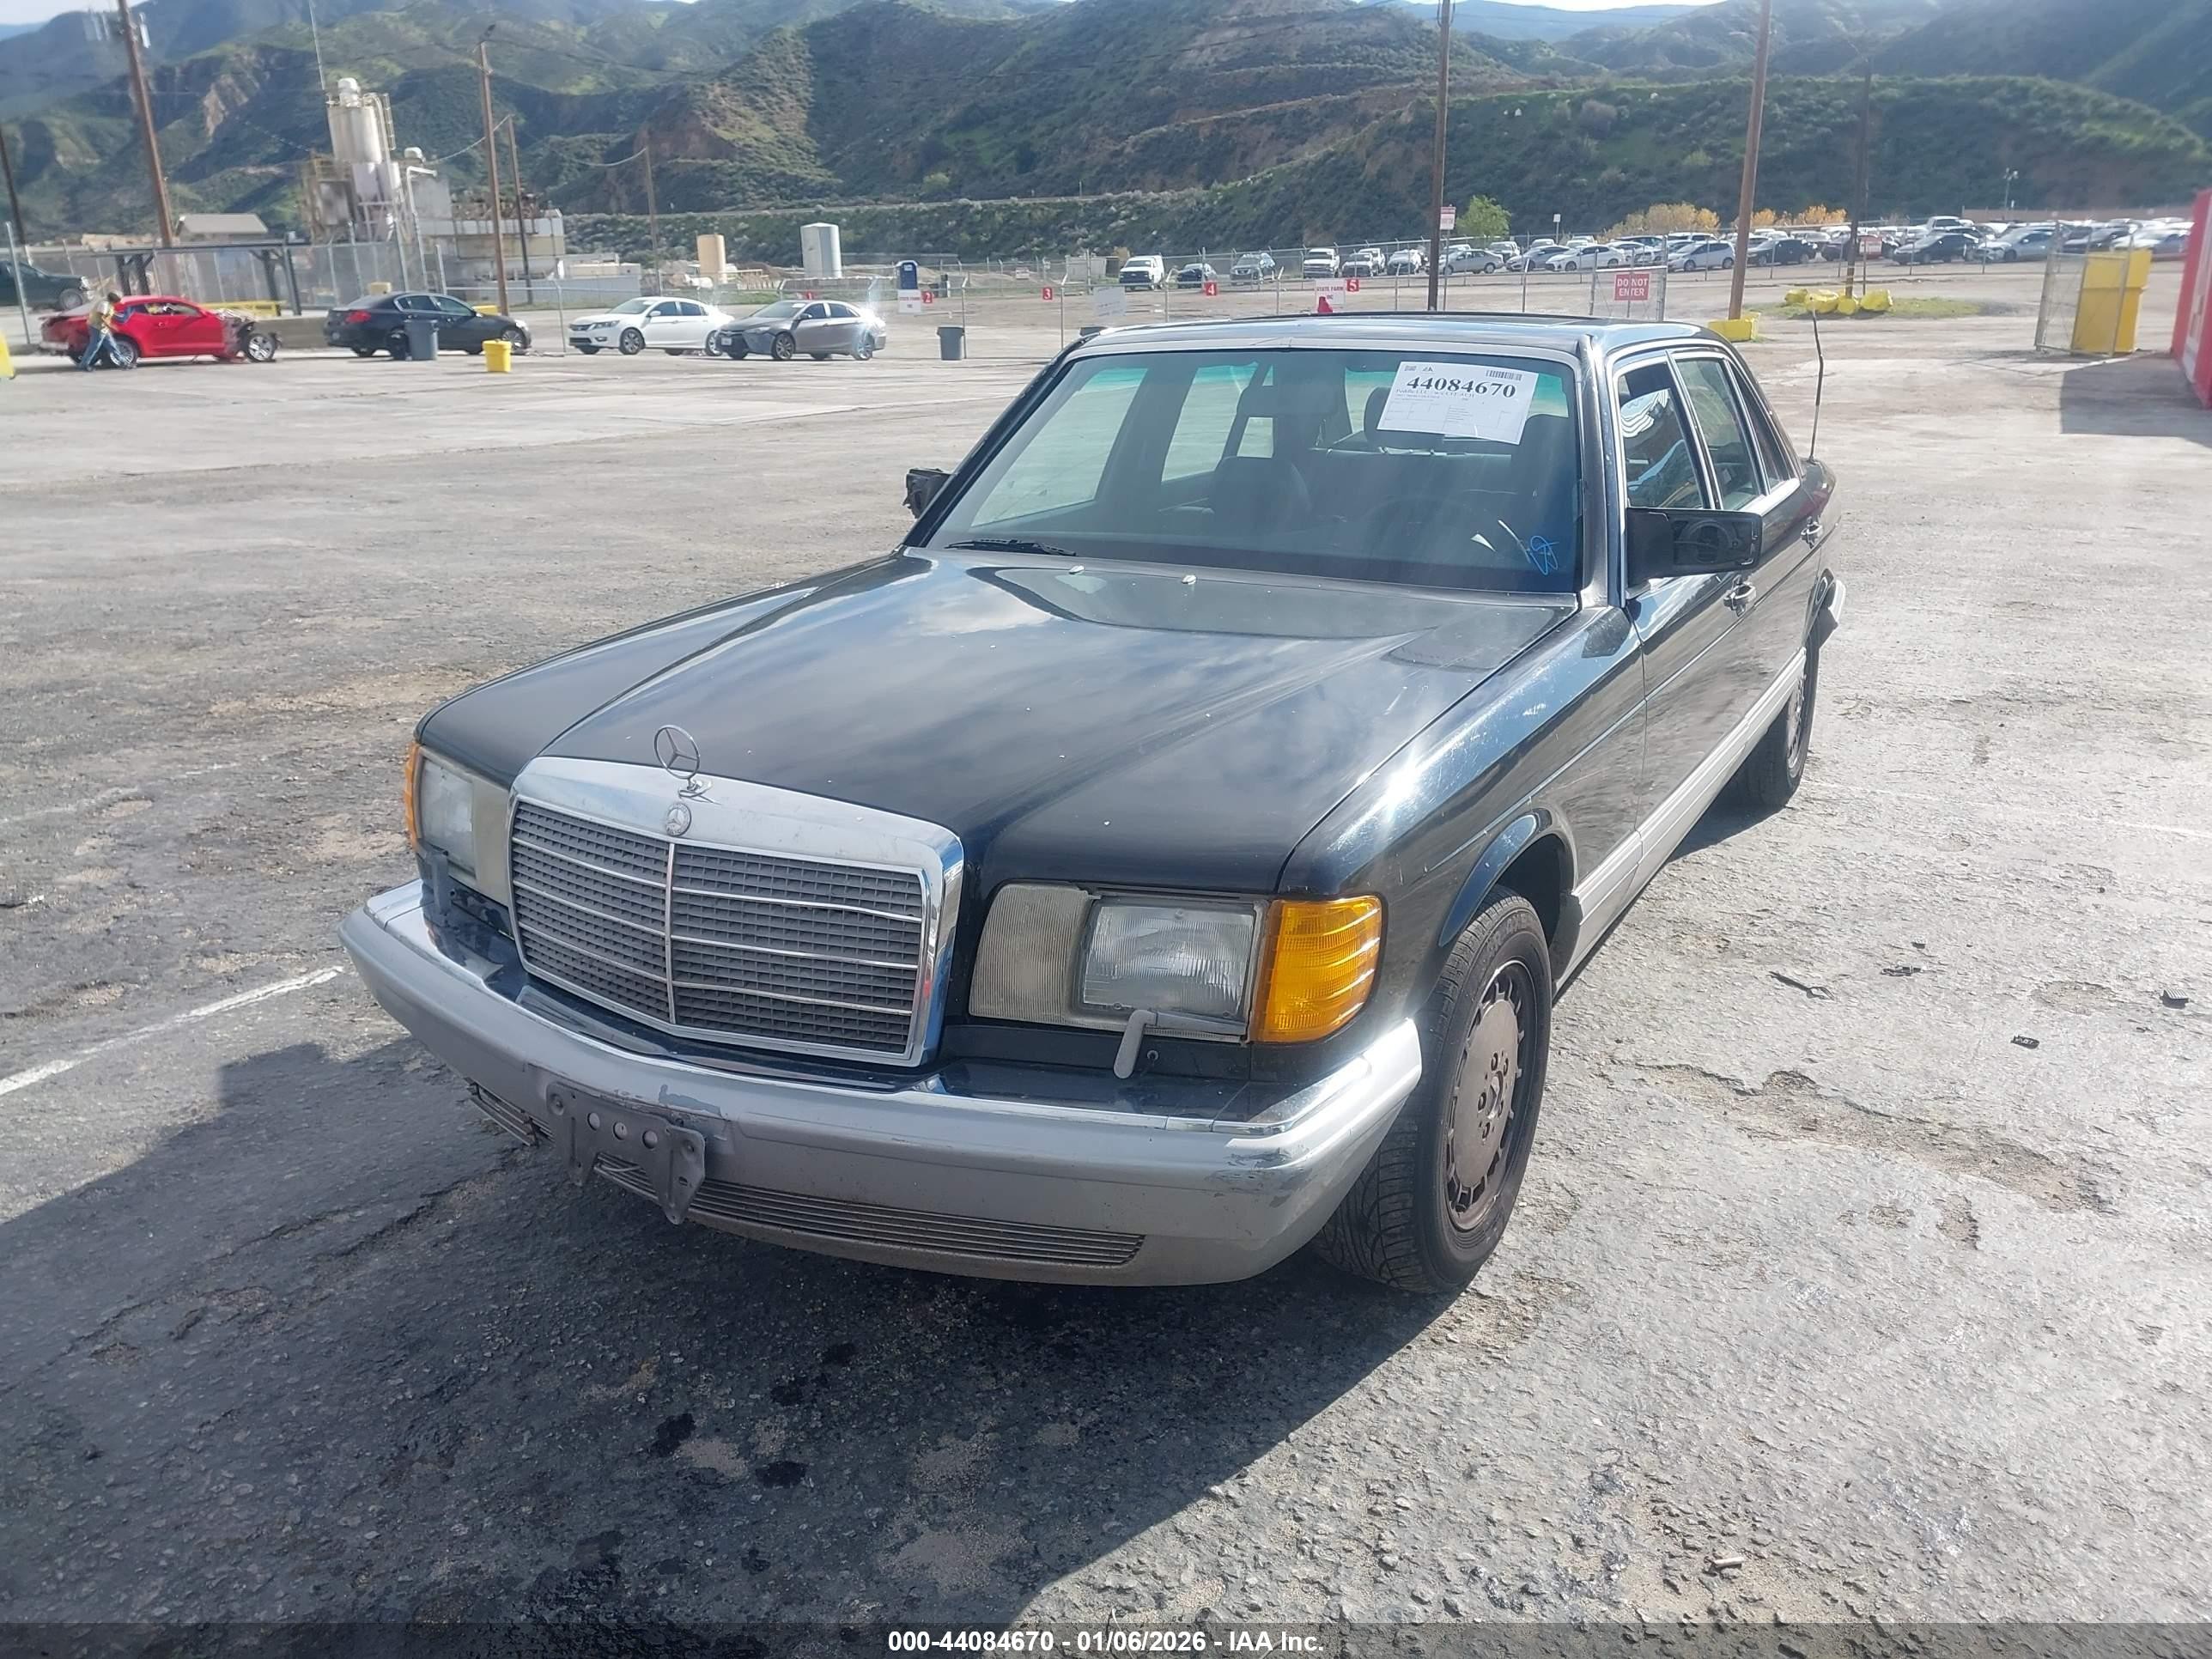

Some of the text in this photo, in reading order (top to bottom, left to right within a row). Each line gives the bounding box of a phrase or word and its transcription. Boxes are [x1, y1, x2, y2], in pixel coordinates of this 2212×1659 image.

[1349, 279, 1358, 292] 5
[1617, 278, 1648, 287] DO NOT
[1043, 288, 1051, 300] 3
[1207, 283, 1215, 295] 4
[1619, 288, 1645, 296] ENTER
[923, 292, 932, 303] 2
[1406, 376, 1517, 398] 44084670
